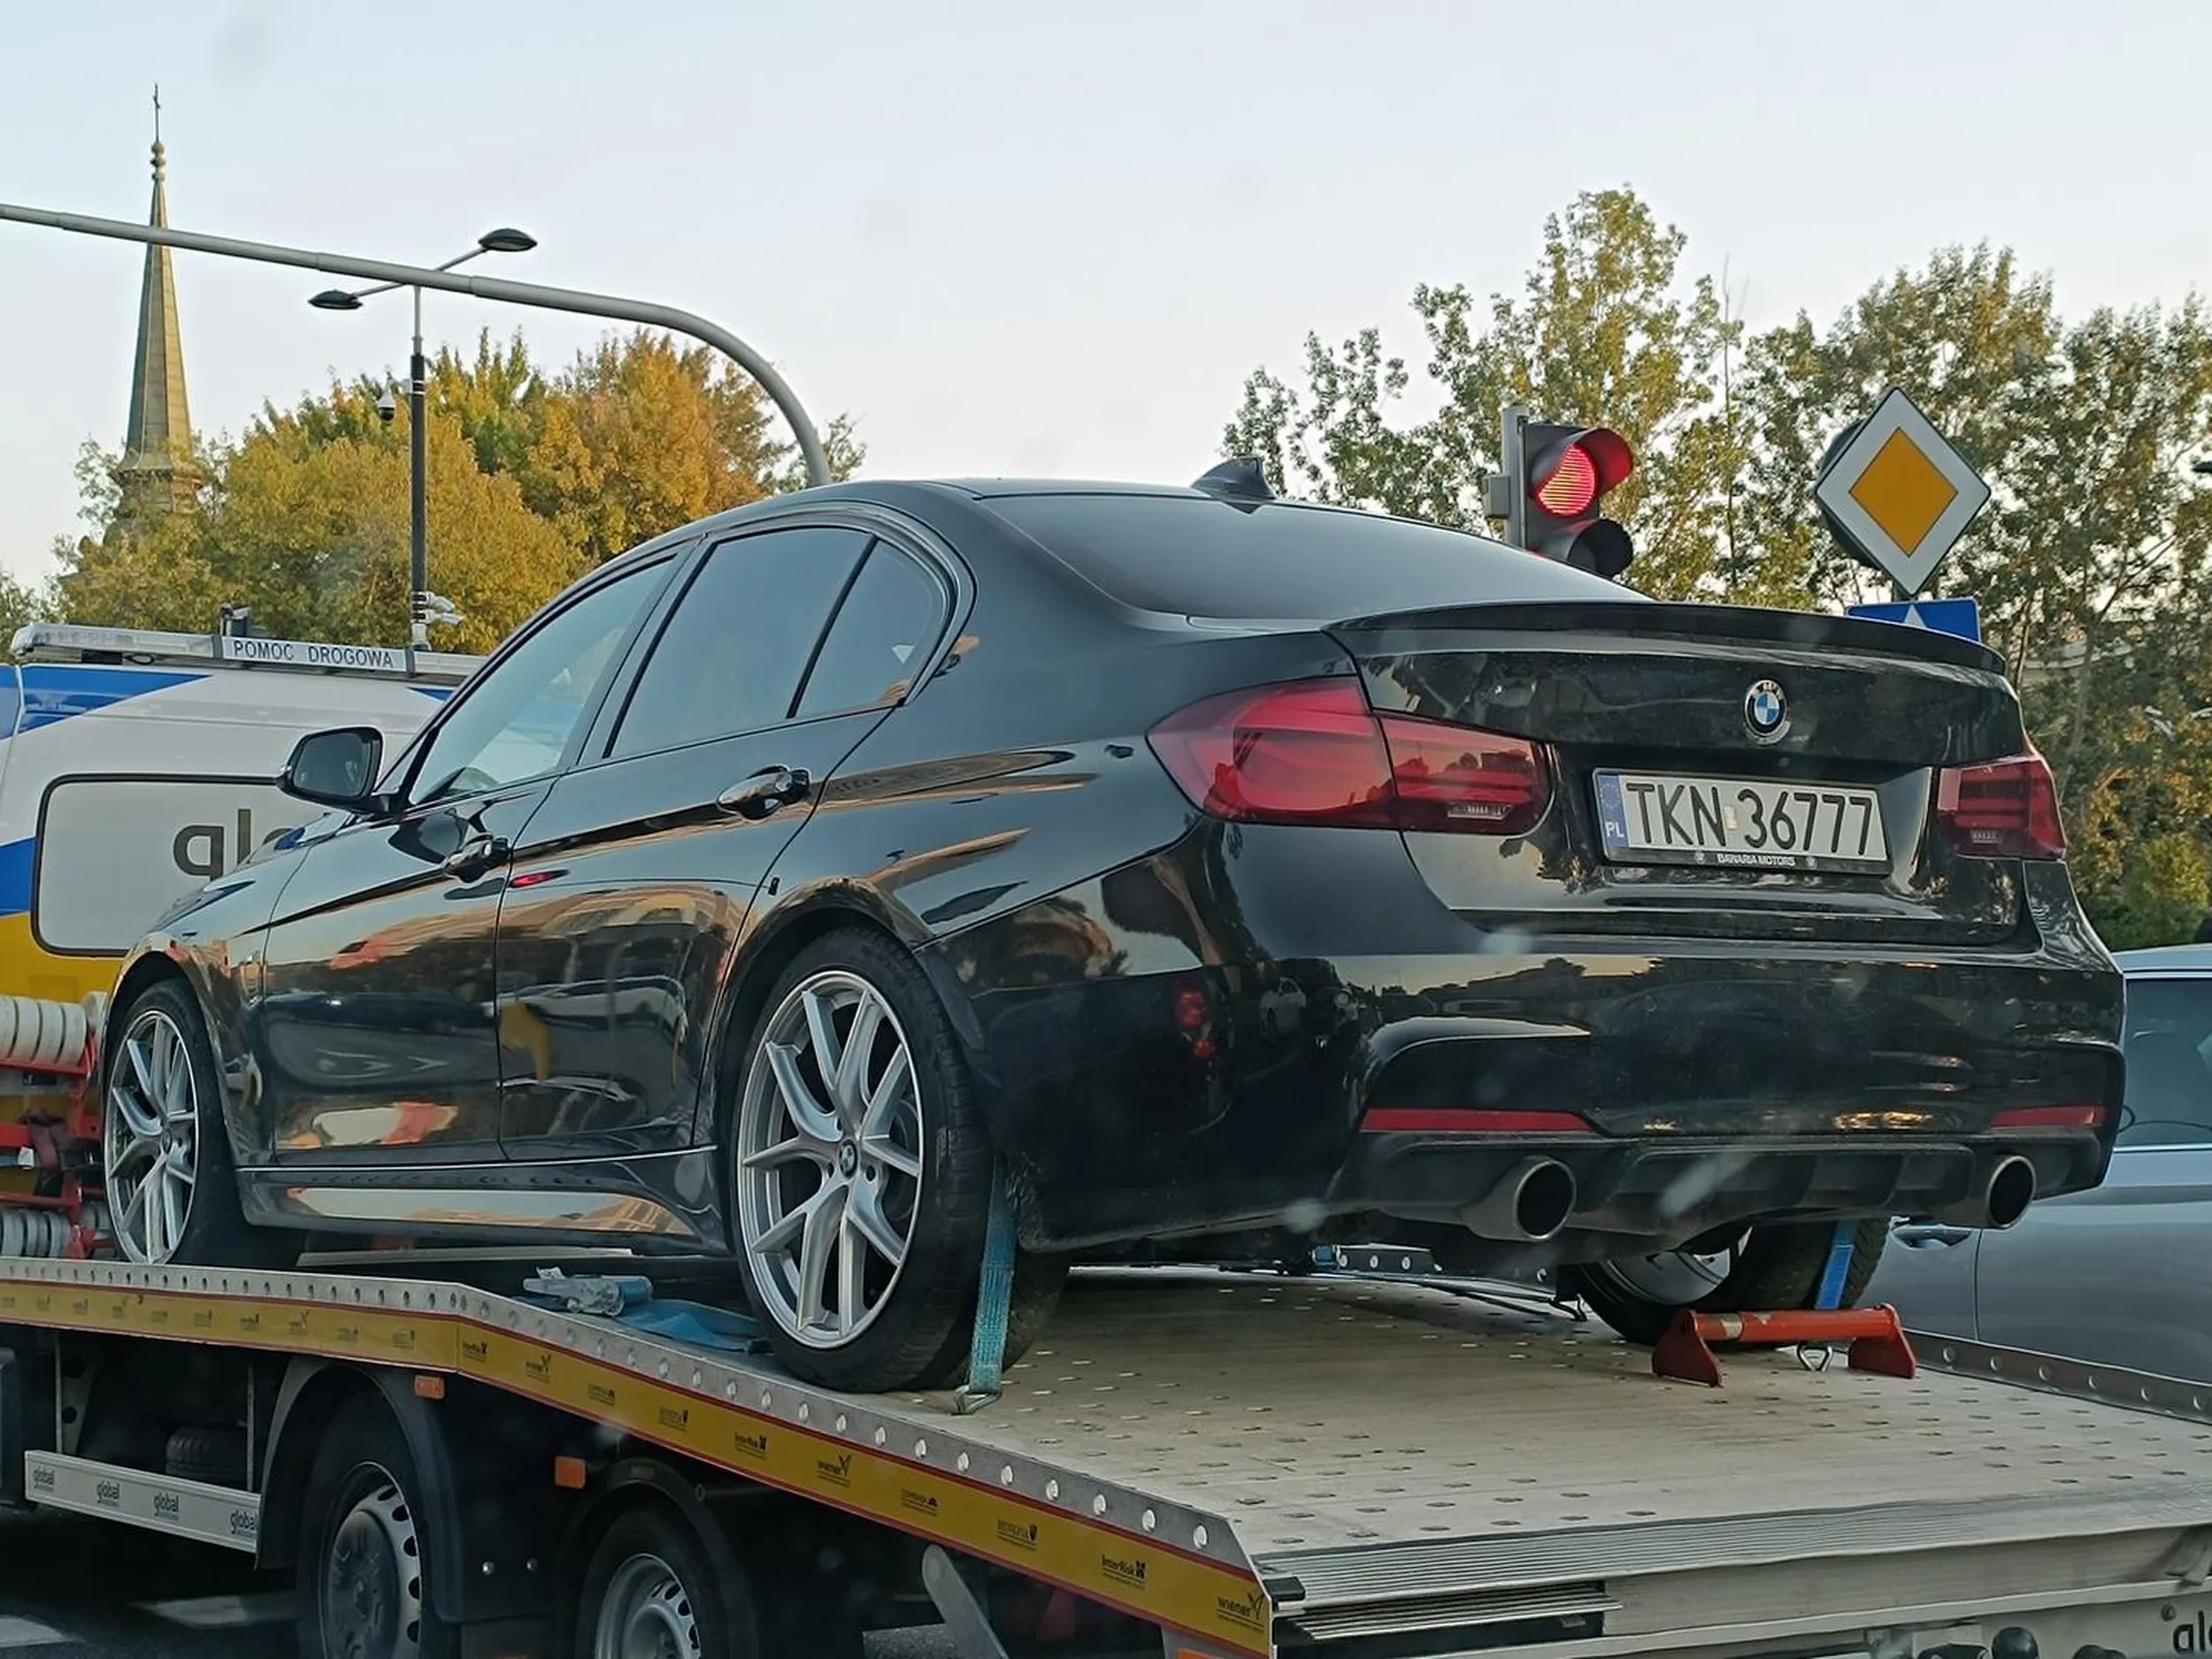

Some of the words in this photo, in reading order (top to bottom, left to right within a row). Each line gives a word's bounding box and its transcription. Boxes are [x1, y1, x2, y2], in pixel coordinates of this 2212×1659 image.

[234, 640, 295, 661] POMOC
[309, 645, 395, 669] DROGOWA
[1604, 820, 1625, 839] PL
[1625, 782, 1727, 847] TKN
[1737, 788, 1873, 856] 36777
[1757, 854, 1796, 867] MOTORS
